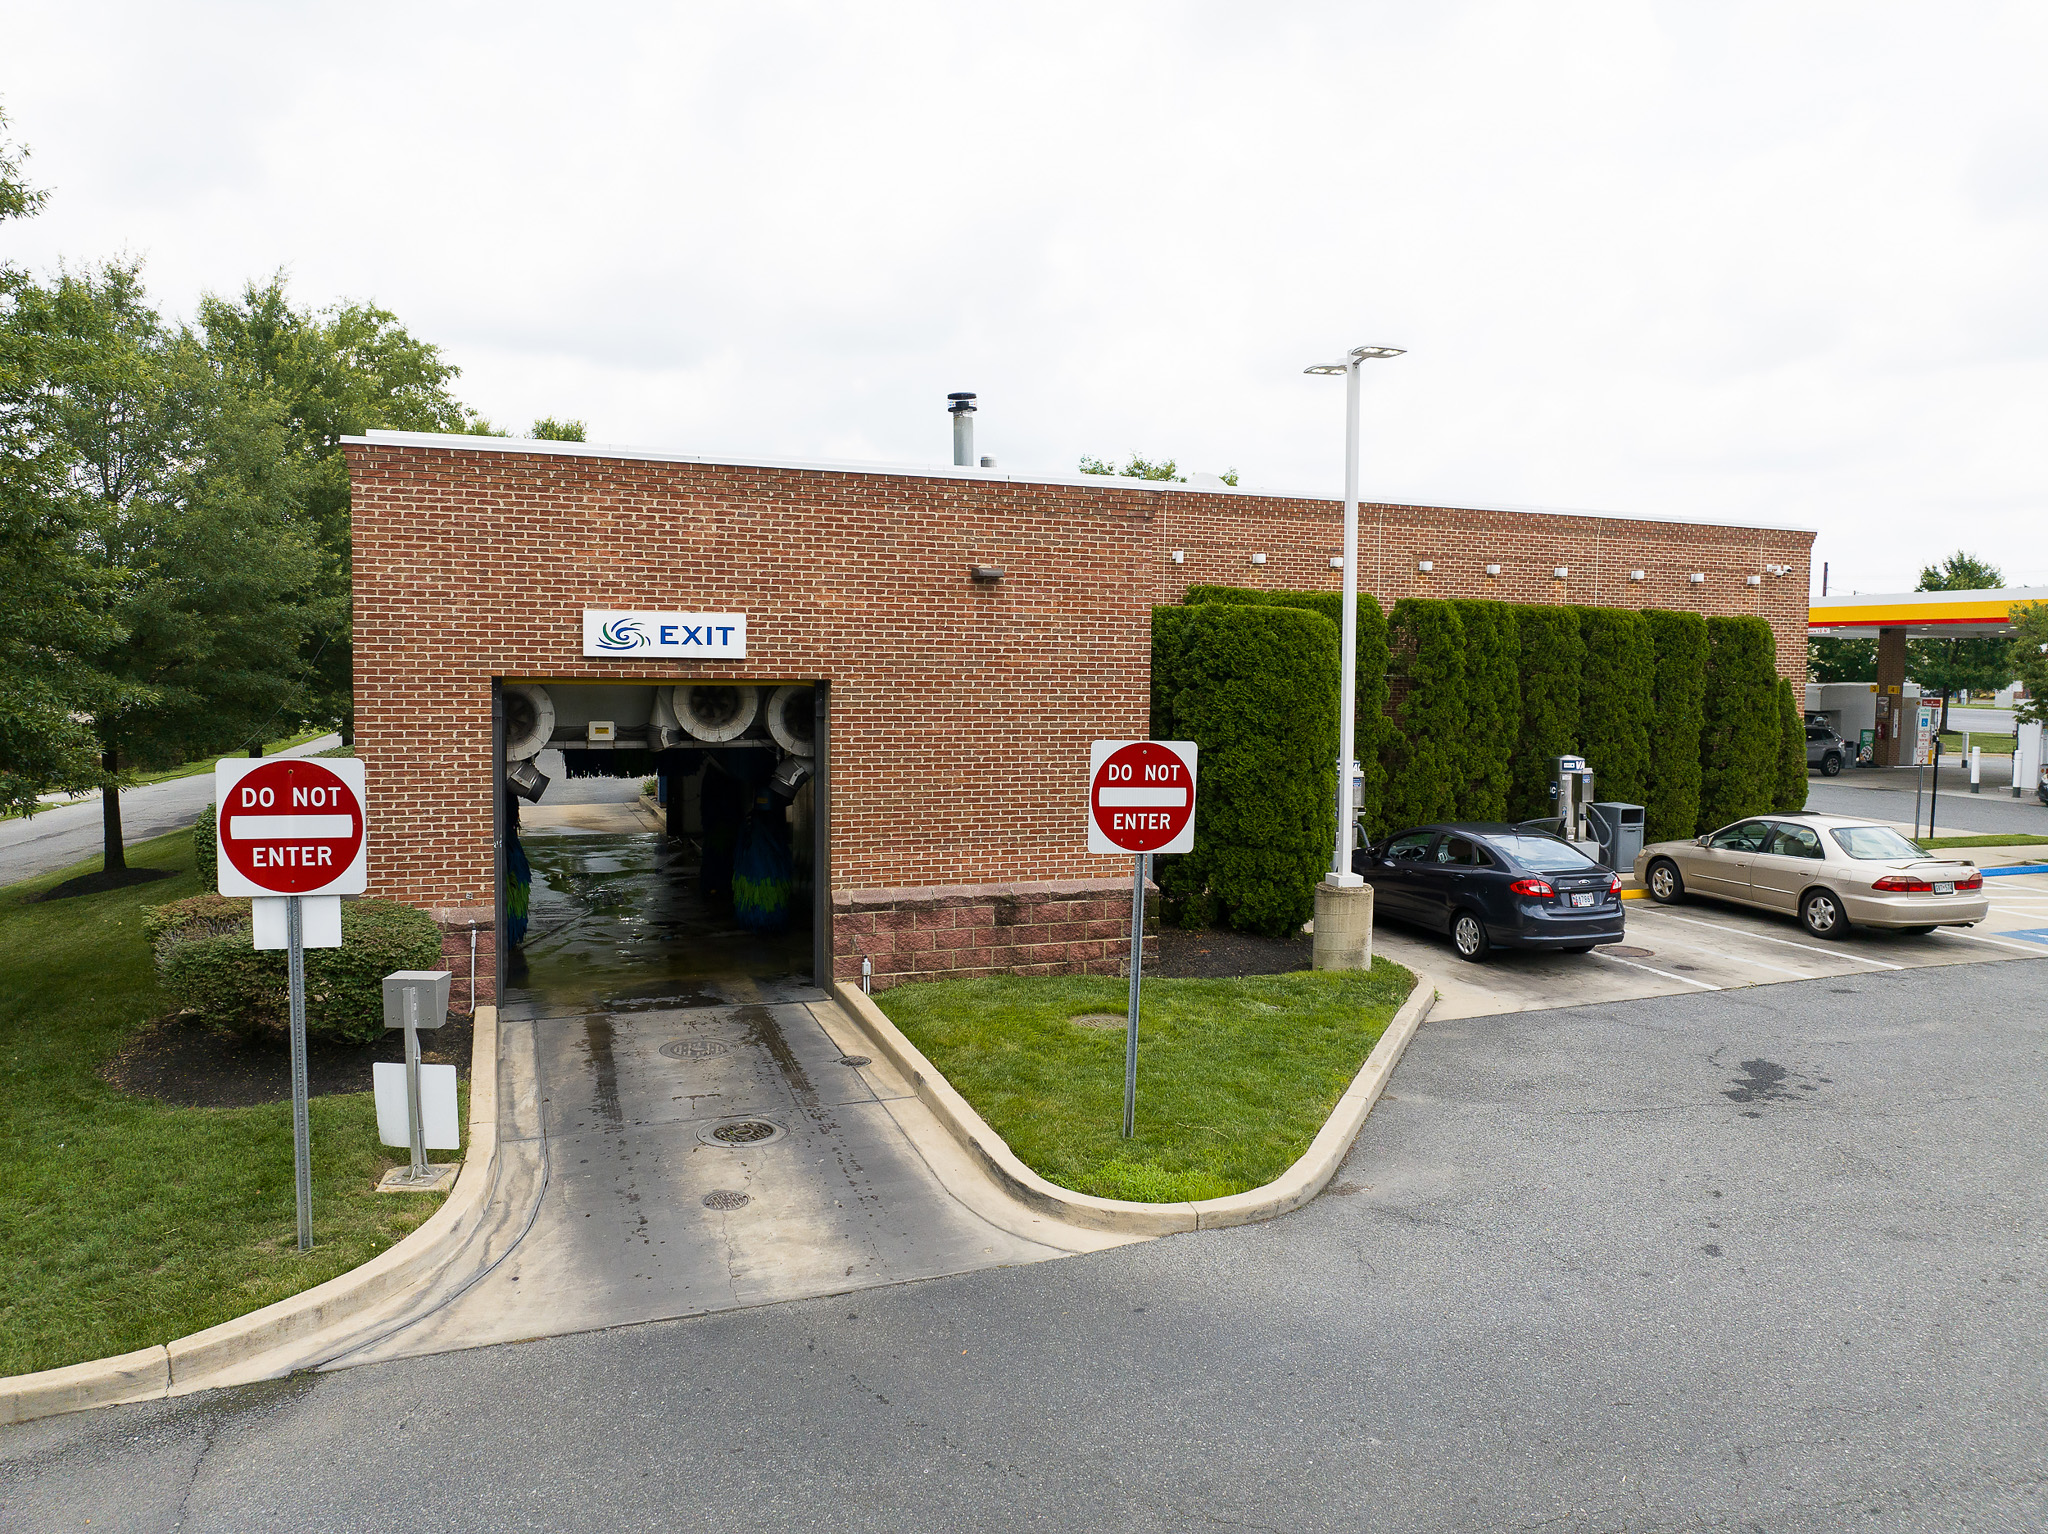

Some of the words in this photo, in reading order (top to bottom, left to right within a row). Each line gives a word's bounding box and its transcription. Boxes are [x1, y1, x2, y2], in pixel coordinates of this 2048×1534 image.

[660, 625, 735, 646] EXIT
[1108, 763, 1132, 781] DO
[1144, 764, 1180, 781] NOT
[241, 787, 275, 808] DO
[292, 786, 342, 807] NOT
[1113, 813, 1171, 830] ENTER
[252, 846, 333, 868] ENTER
